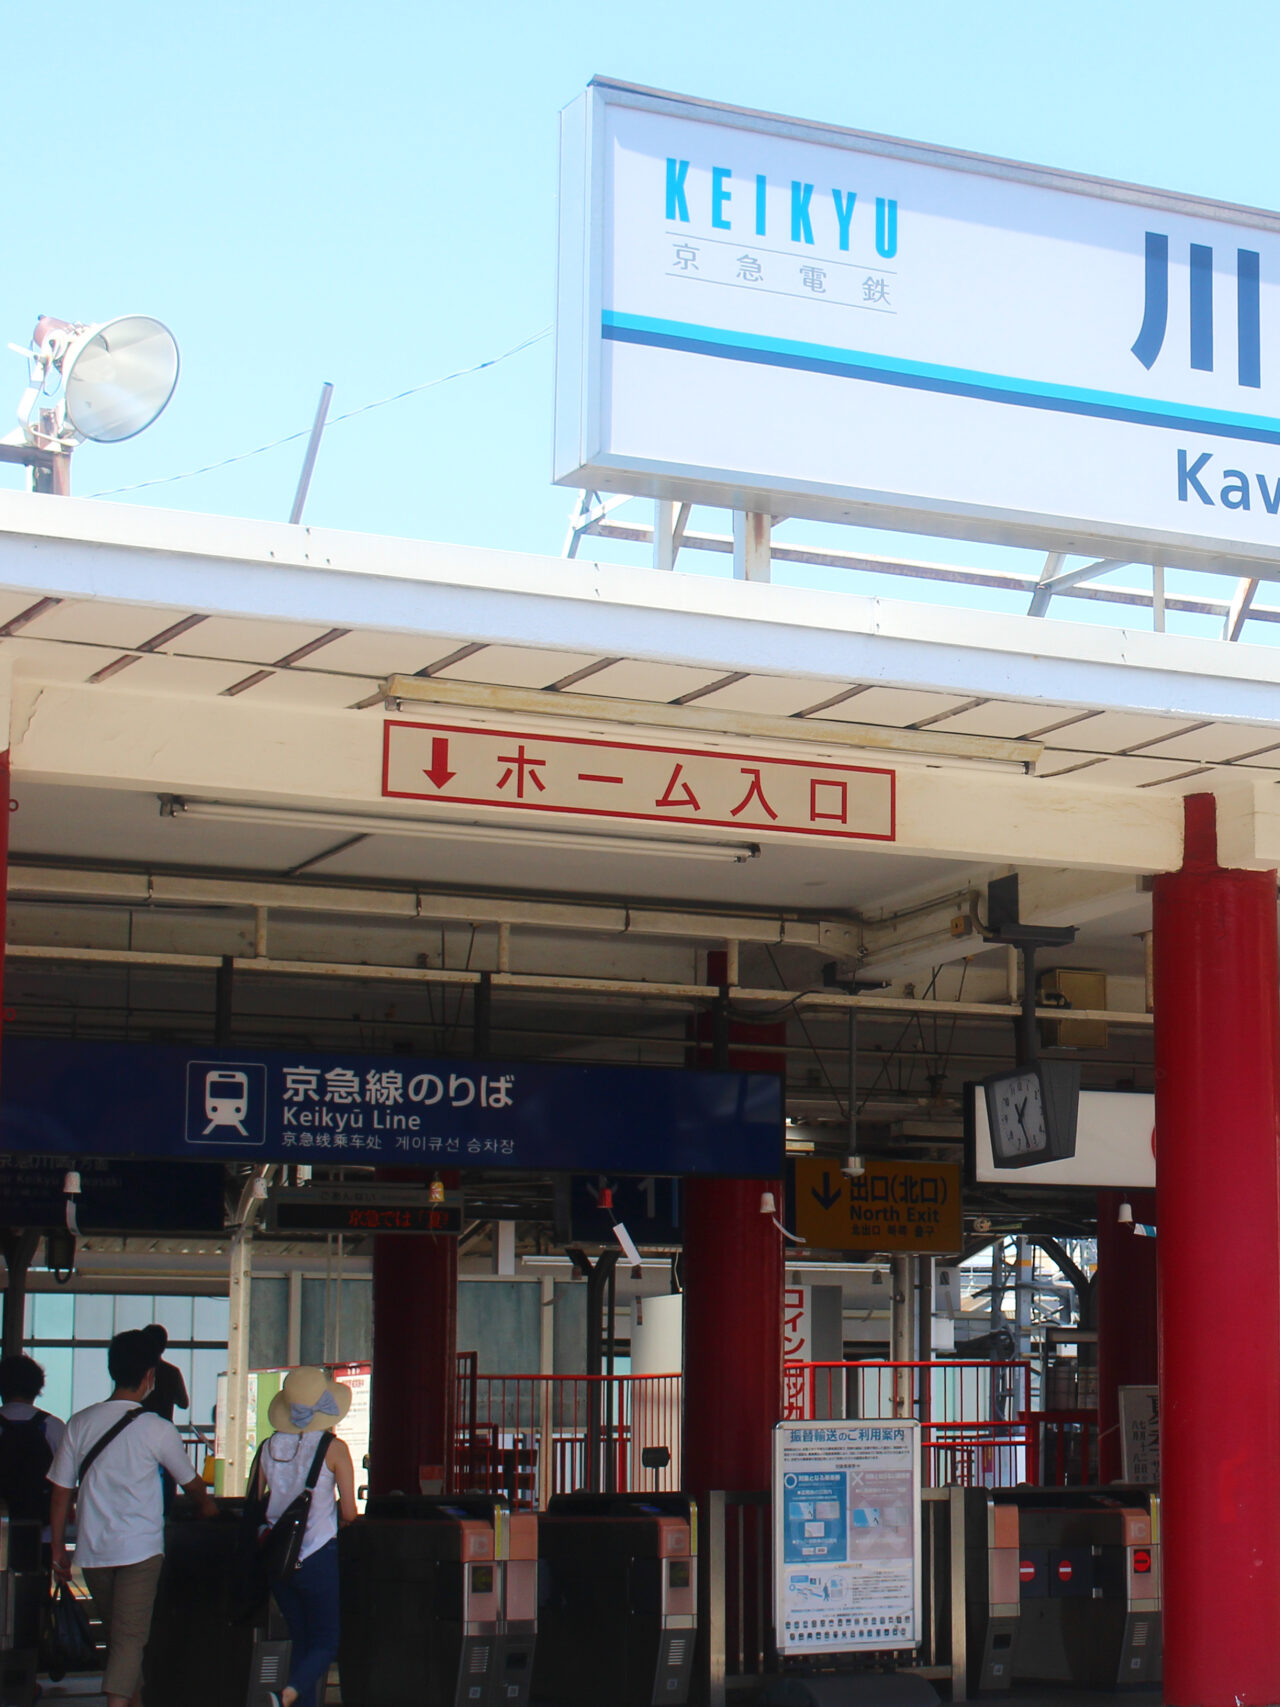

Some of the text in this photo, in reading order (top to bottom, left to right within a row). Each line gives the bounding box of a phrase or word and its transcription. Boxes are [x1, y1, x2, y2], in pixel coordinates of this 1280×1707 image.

[665, 157, 898, 260] KEIKYU
[672, 242, 892, 306] 京急電鉄
[496, 745, 848, 824] ホーム入口
[282, 1066, 515, 1108] 京急線のりば
[283, 1106, 421, 1131] Keikyū Line
[395, 1135, 514, 1155] 게이큐선 승차장
[850, 1175, 947, 1206] 出口(北口)
[850, 1206, 940, 1223] North Exit
[790, 1428, 905, 1443] 振替輸送のご利用案内
